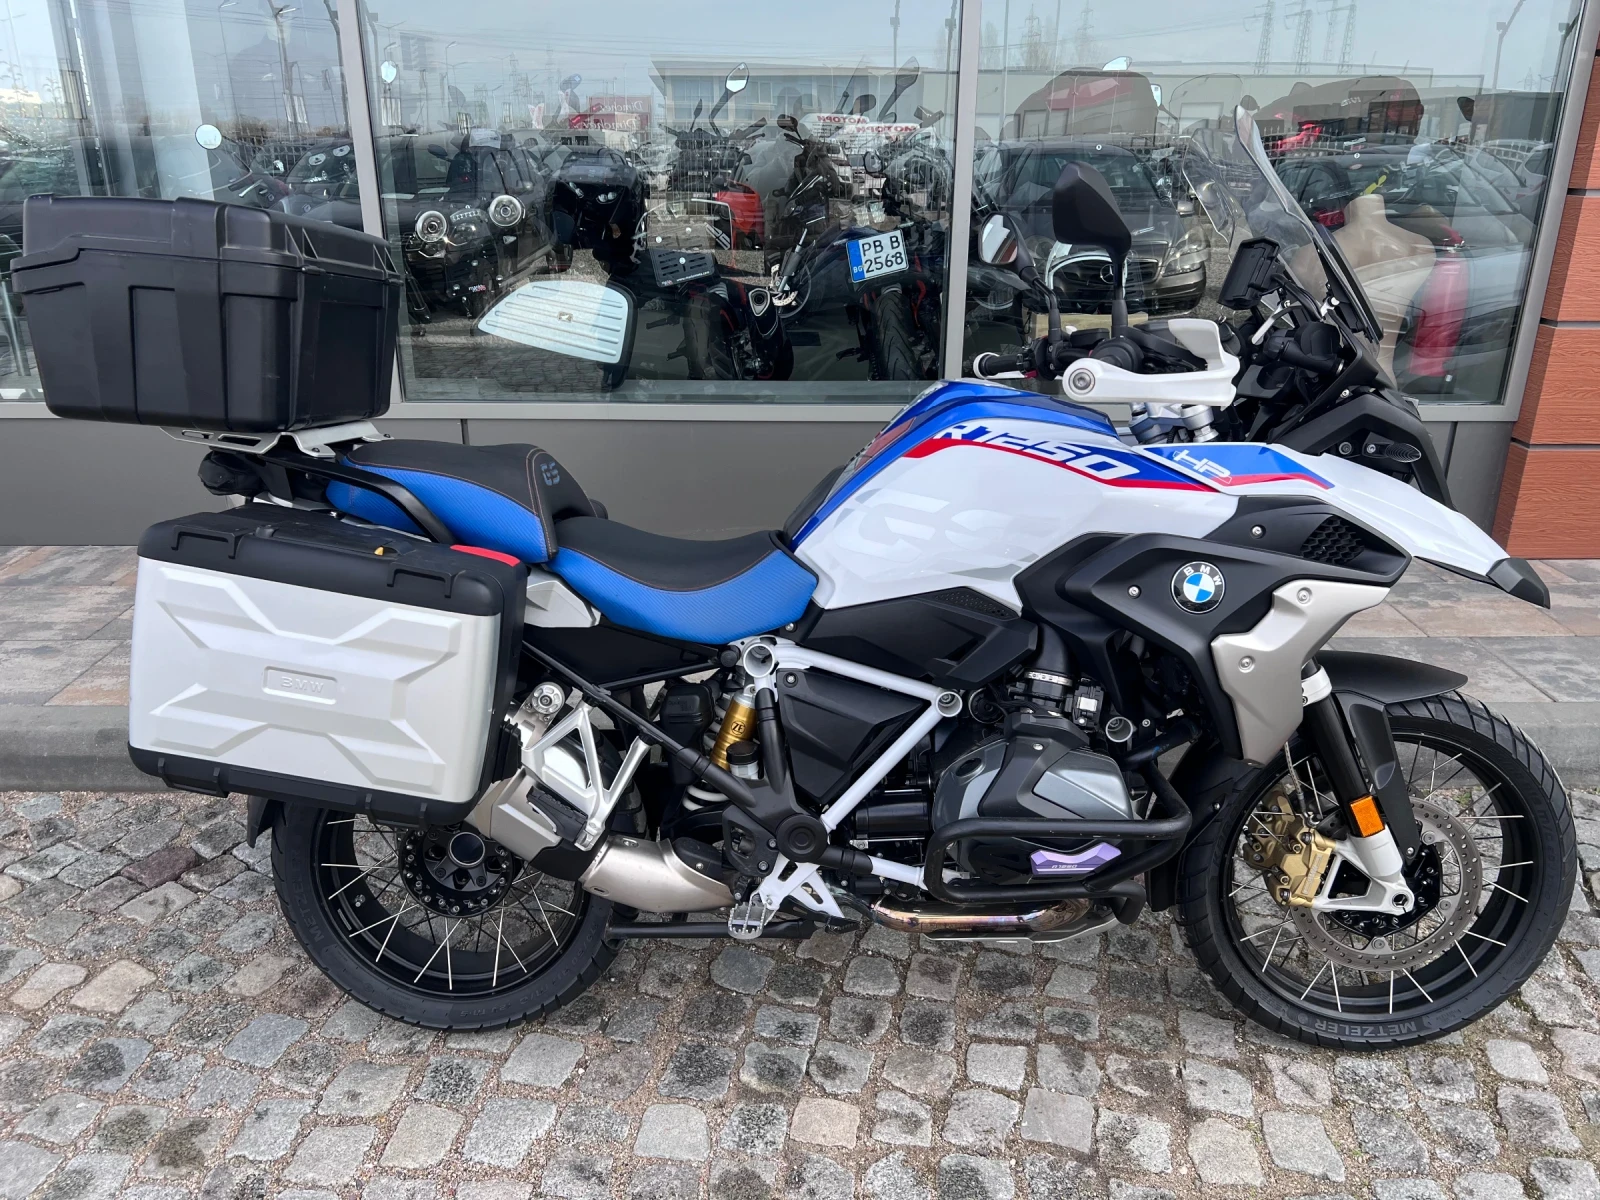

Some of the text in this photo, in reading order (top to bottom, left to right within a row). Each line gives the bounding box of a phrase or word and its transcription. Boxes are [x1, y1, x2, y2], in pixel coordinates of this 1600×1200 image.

[861, 235, 901, 257] PB B
[853, 265, 863, 274] BG
[864, 251, 904, 274] 2568
[540, 461, 560, 486] GS
[1173, 449, 1231, 482] HP
[1183, 564, 1223, 586] BMW
[281, 676, 324, 693] BMW
[1314, 1018, 1418, 1037] METZELER
